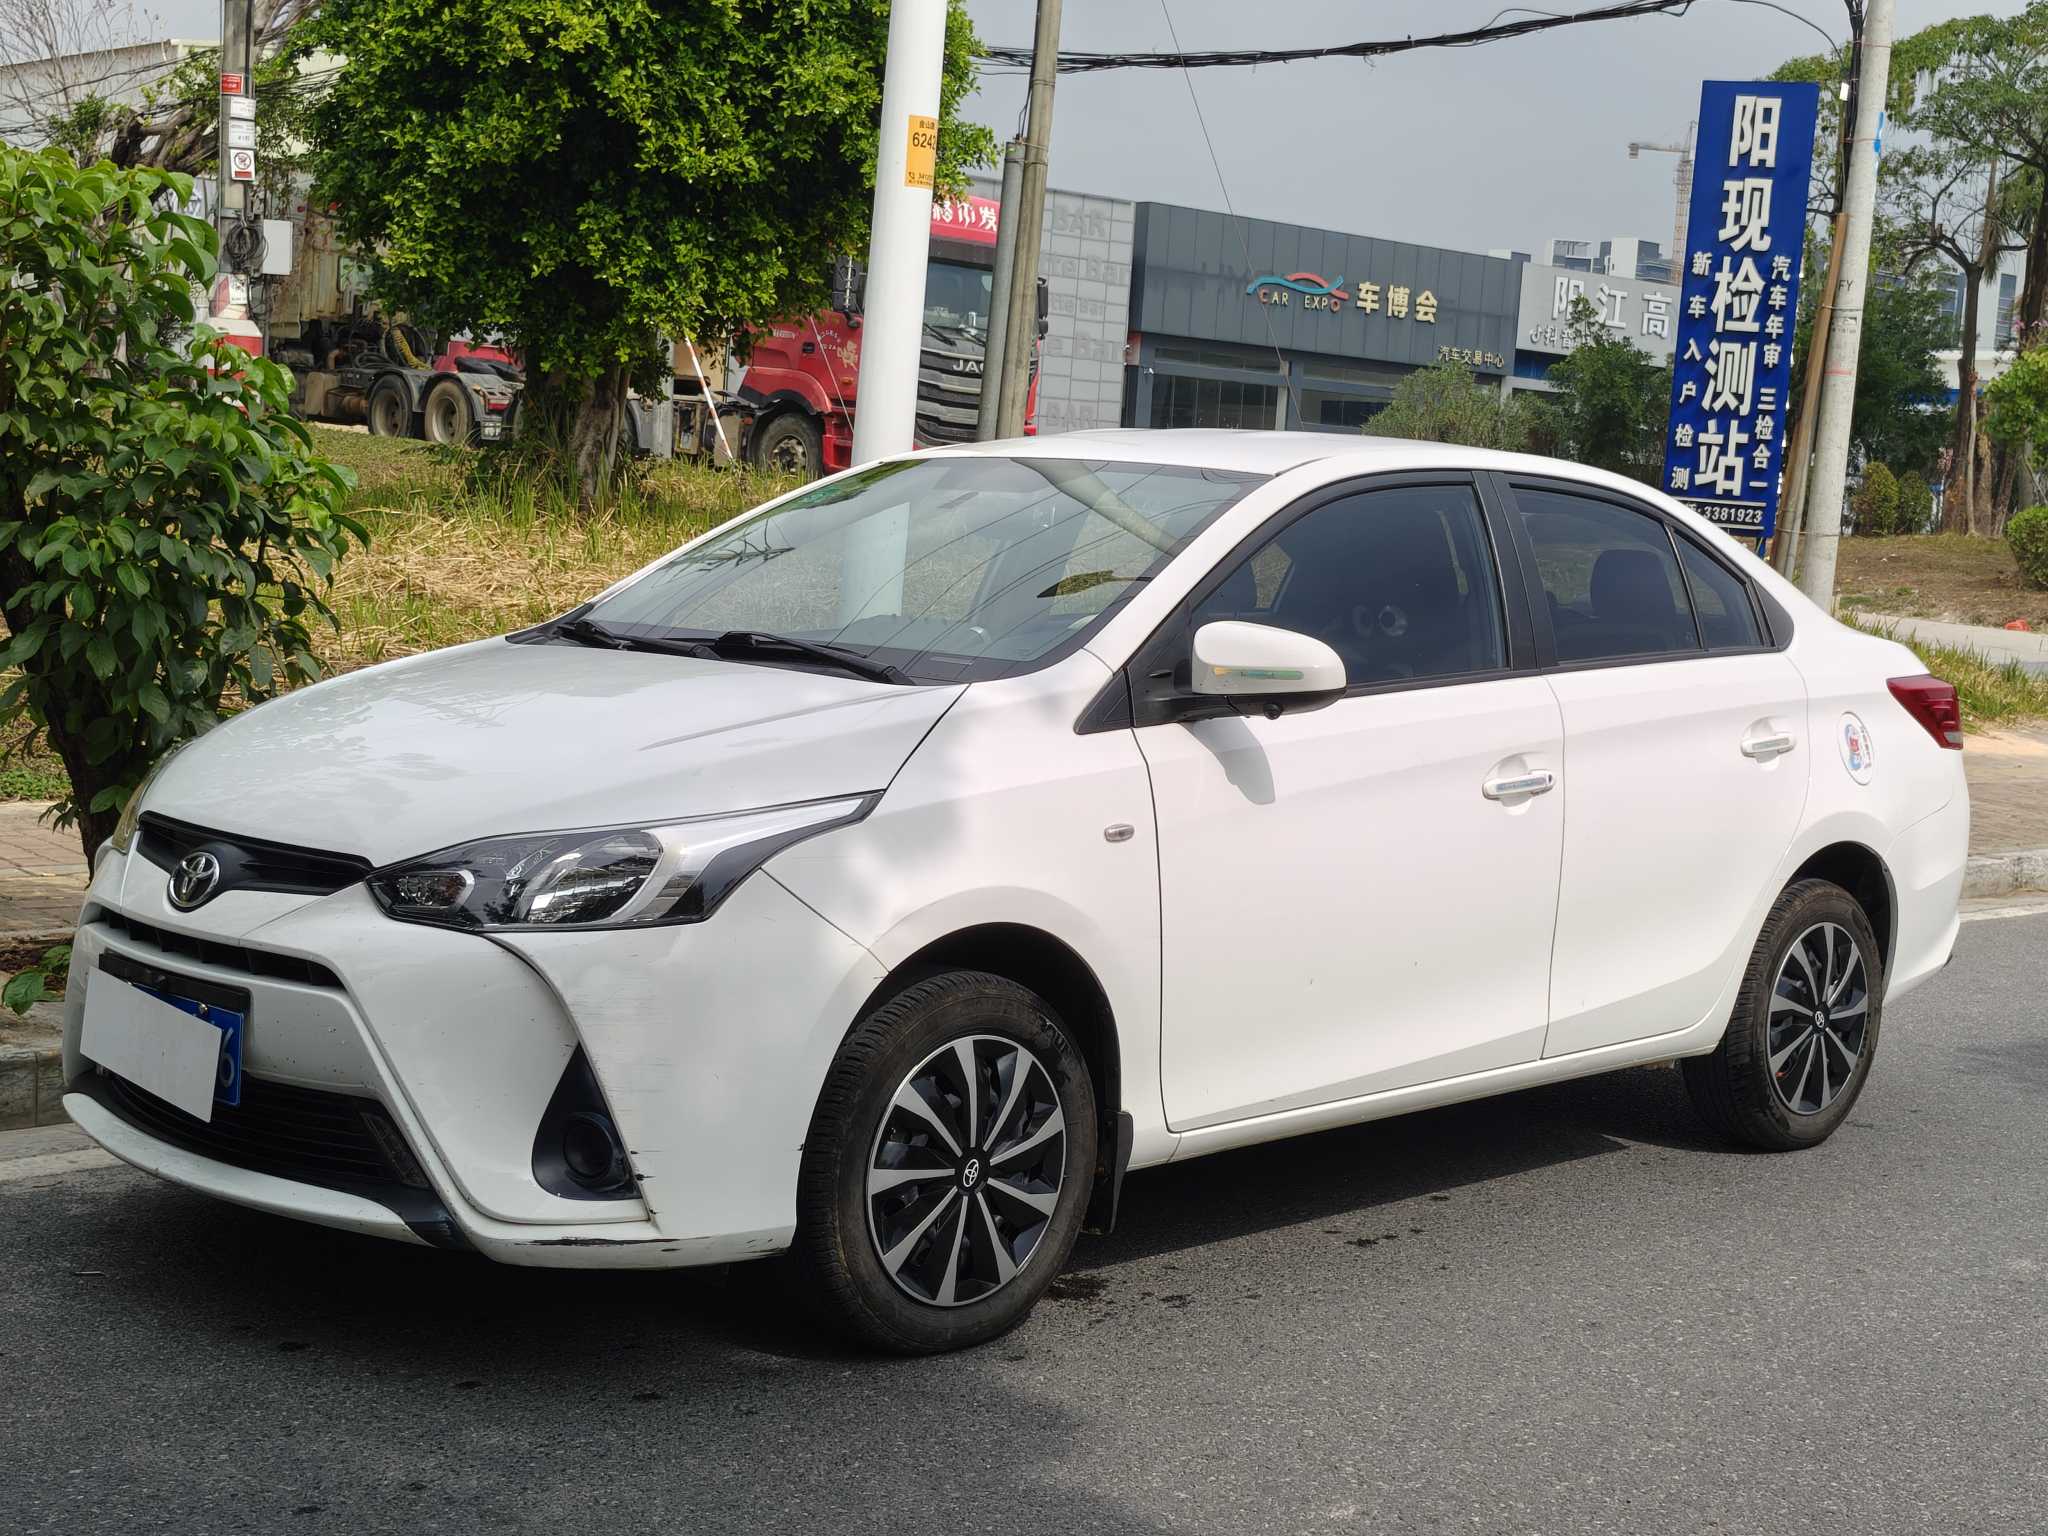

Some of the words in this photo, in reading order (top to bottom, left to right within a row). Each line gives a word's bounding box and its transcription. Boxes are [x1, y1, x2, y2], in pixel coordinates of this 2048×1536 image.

[1052, 204, 1106, 238] BAR
[1259, 288, 1289, 306] CAR
[1303, 294, 1341, 313] EXPO
[1356, 280, 1439, 325] 车博会
[1551, 276, 1674, 340] 阳江高
[1695, 95, 1782, 497] 阳现检测站
[1764, 255, 1792, 369] 汽车年审
[1439, 345, 1505, 368] 汽车交易中心
[1670, 251, 1713, 491] 新车入户检测
[1749, 386, 1777, 489] 三检合一
[1702, 506, 1763, 524] 3381923
